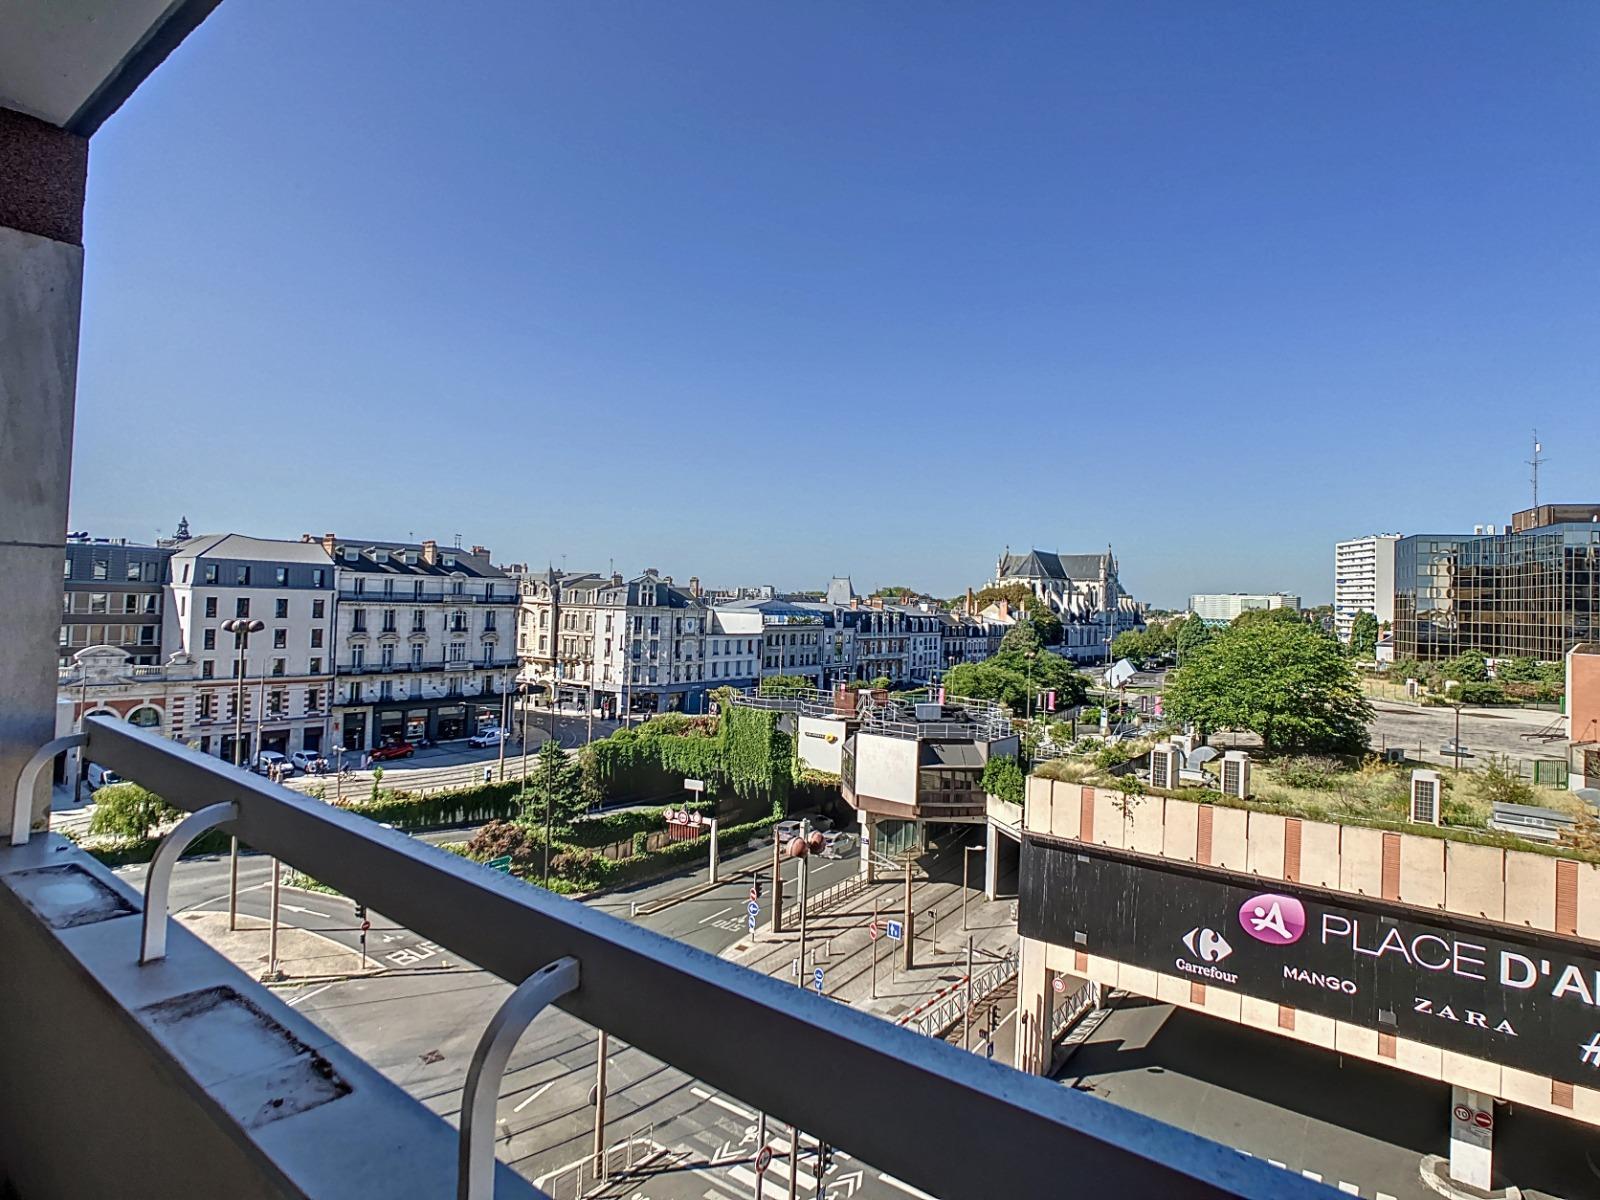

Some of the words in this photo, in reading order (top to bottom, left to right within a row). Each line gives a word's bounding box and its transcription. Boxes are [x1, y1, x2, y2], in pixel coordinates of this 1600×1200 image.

[1175, 957, 1239, 985] Carrefour
[1321, 913, 1487, 981] PLACE
[1499, 950, 1600, 1006] D'A
[1283, 964, 1358, 995] MANGO
[1413, 996, 1520, 1037] ZARA
